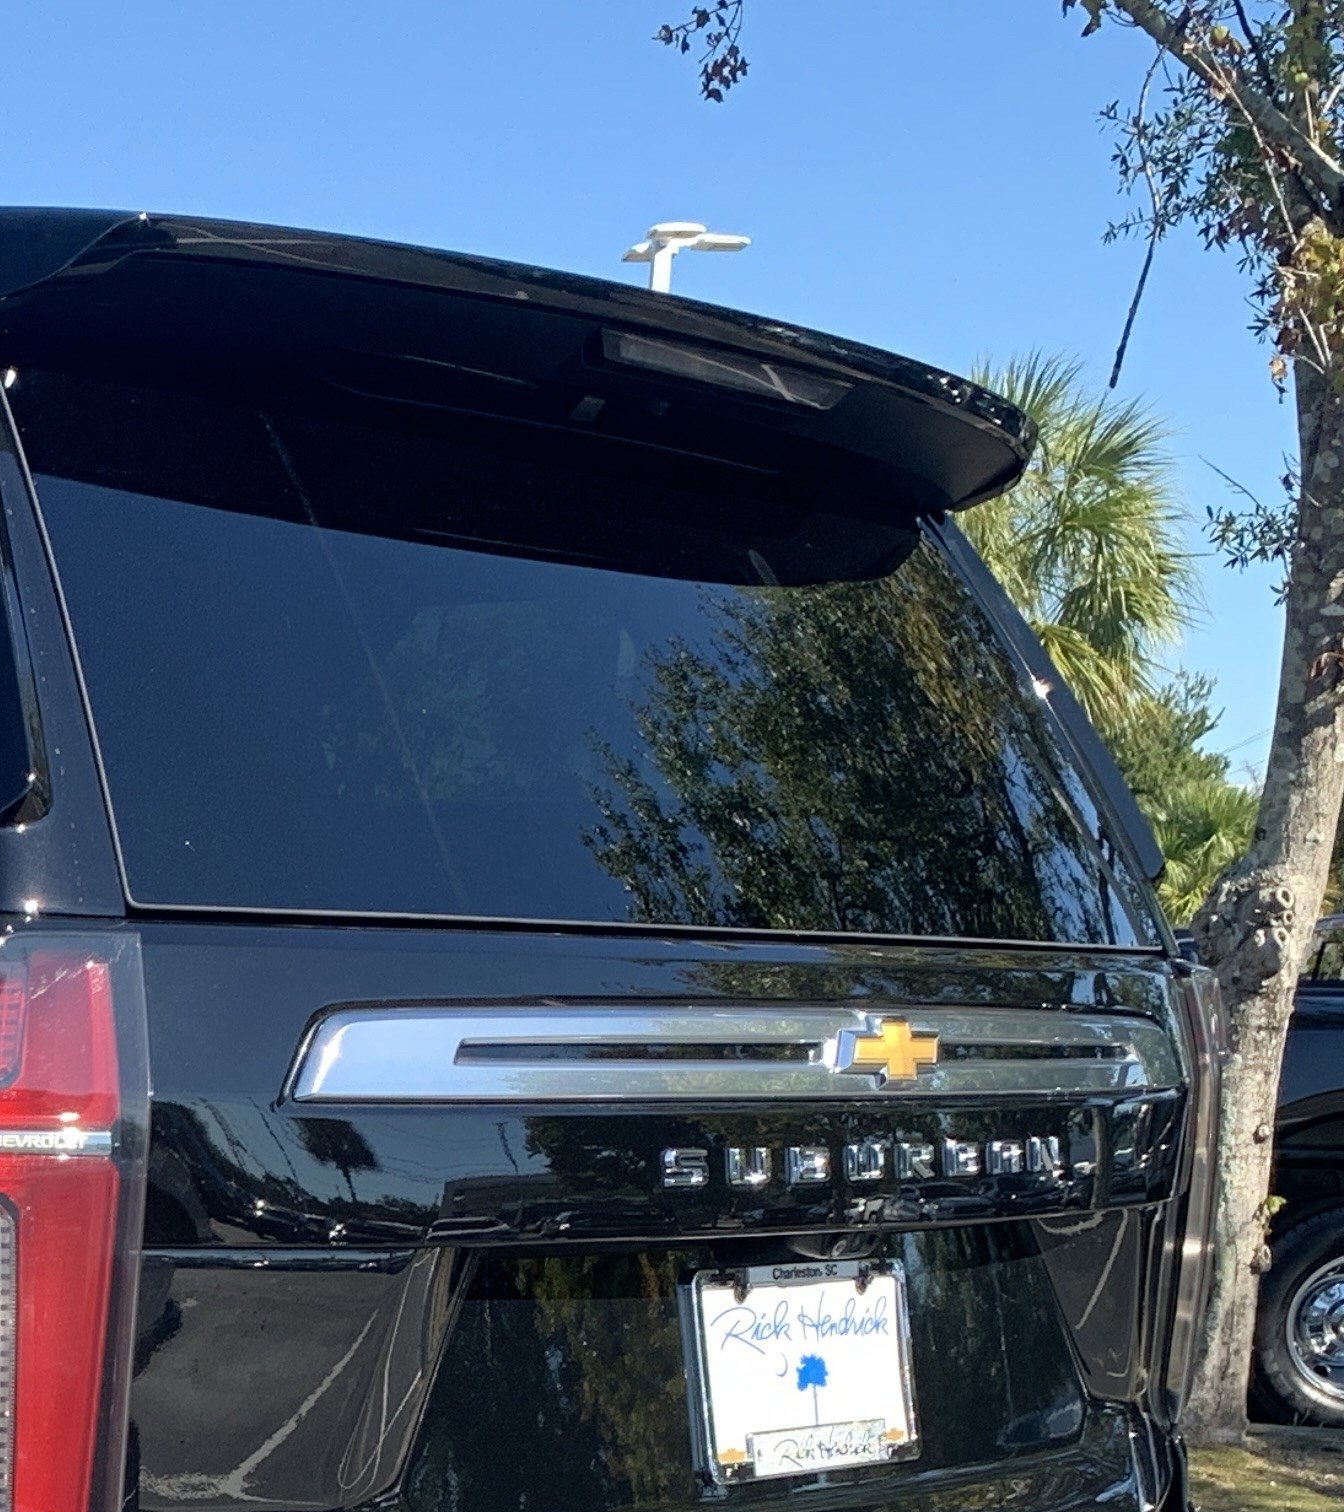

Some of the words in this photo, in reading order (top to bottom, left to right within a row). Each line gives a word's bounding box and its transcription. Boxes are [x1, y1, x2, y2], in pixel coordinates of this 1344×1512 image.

[660, 1135, 1060, 1190] SUBURBAN
[825, 1263, 838, 1277] SC
[710, 1300, 792, 1355] Rick
[797, 1290, 889, 1342] Hendrick
